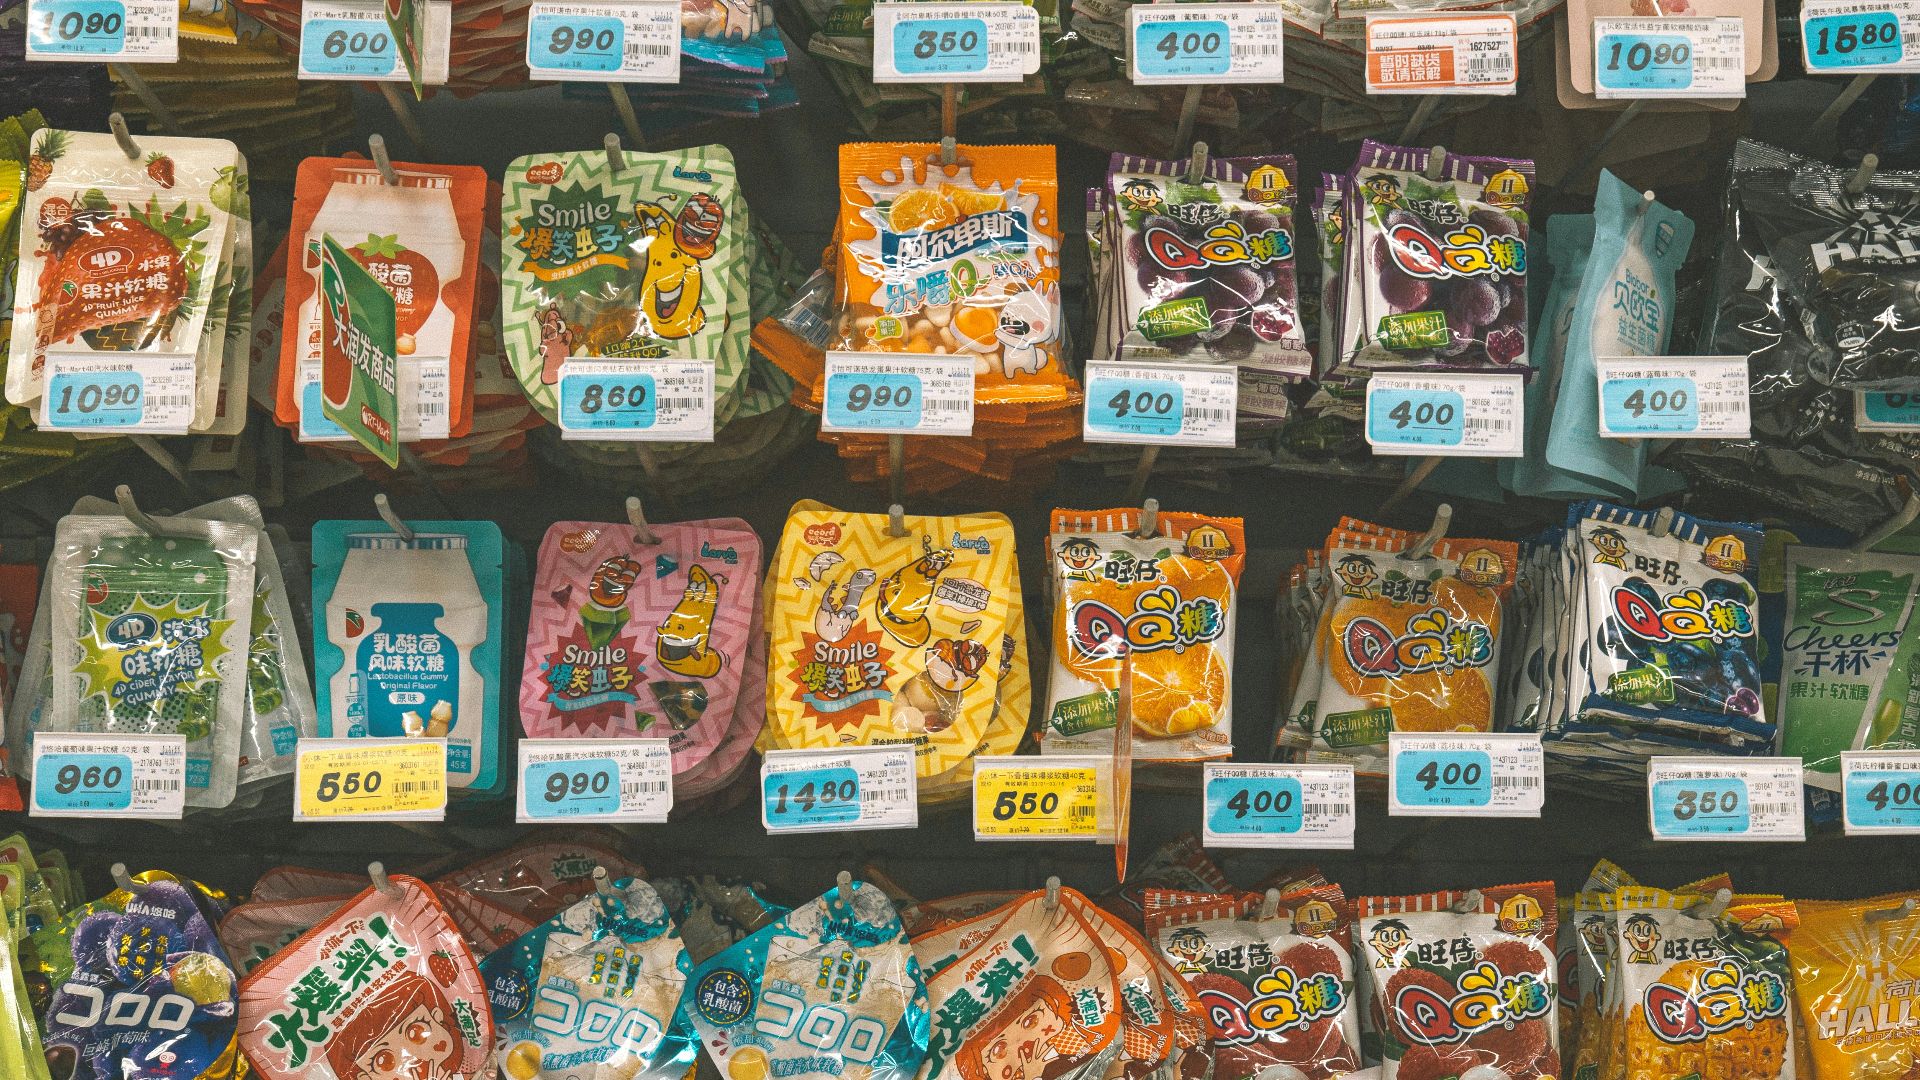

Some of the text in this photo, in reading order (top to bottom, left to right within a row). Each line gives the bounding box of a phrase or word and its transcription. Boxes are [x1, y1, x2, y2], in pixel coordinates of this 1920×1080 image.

[323, 30, 388, 58] 600
[549, 26, 615, 54] 990
[913, 30, 978, 59] 350
[1156, 32, 1221, 60] 400
[1469, 42, 1500, 51] 1627527
[1380, 53, 1441, 67] 暂时缺货
[1381, 68, 1441, 82] 敬请谅解
[537, 200, 612, 230] Smile
[1167, 203, 1222, 225] 旺仔
[1407, 199, 1462, 225] 旺仔
[520, 224, 624, 261] 爆笑虫子
[895, 210, 1015, 263] 阿尔卑斯
[1145, 219, 1294, 271] QQ糖
[90, 250, 122, 267] 4D
[137, 255, 171, 273] 水果
[1389, 223, 1527, 280] QQ糖
[81, 271, 169, 300] 果汁软糖
[1387, 316, 1443, 336] 添加果汁
[332, 313, 396, 396] 大润发商品
[57, 384, 140, 413] 1090
[579, 384, 646, 414] 860
[846, 384, 913, 412] 990
[1108, 390, 1174, 417] 400
[1624, 389, 1689, 418] 400
[1389, 400, 1454, 429] 400
[1104, 557, 1161, 582] 旺仔
[1634, 554, 1682, 586] 旺仔
[1380, 579, 1433, 606] 旺仔
[1071, 585, 1225, 660] QQ糖
[1610, 585, 1755, 643] QQ糖
[117, 621, 145, 638] 4D
[161, 617, 211, 642] 汽水
[373, 633, 441, 653] 乳酸菌
[1344, 607, 1495, 679] QQ糖
[1783, 626, 1904, 651] Cheers
[122, 643, 203, 679] 味软糖
[368, 654, 445, 673] 风味软糖
[562, 644, 627, 667] Smile
[814, 641, 879, 666] Smile
[1803, 650, 1872, 677] 干杯
[367, 673, 449, 682] Lactobacillus Gummy
[412, 682, 438, 690] Flavor
[547, 664, 634, 694] 爆笑虫子
[800, 661, 887, 693] 爆笑虫子
[126, 686, 176, 706] GUMMY
[396, 693, 418, 704] 原味
[1789, 682, 1870, 701] 果汁软糖
[1331, 714, 1388, 733] 添加果汁
[54, 764, 122, 794] 960
[450, 760, 468, 770] 45克
[1416, 761, 1482, 791] 400
[316, 771, 382, 802] 550
[544, 771, 610, 802] 990
[992, 791, 1059, 821] 550
[1227, 789, 1293, 819] 400
[1673, 790, 1739, 821] 350
[1214, 942, 1273, 970] 旺仔
[1417, 932, 1477, 965] 旺仔
[1663, 936, 1719, 961] 旺仔
[494, 976, 519, 992] 包含
[714, 979, 740, 997] 包含
[703, 992, 743, 1015] 乳酸菌
[1075, 987, 1102, 1027] 大满足
[1197, 965, 1347, 1047] QQ糖
[1395, 961, 1553, 1047] QQ糖
[1643, 959, 1789, 1045] QQ糖
[454, 997, 482, 1049] 大满足
